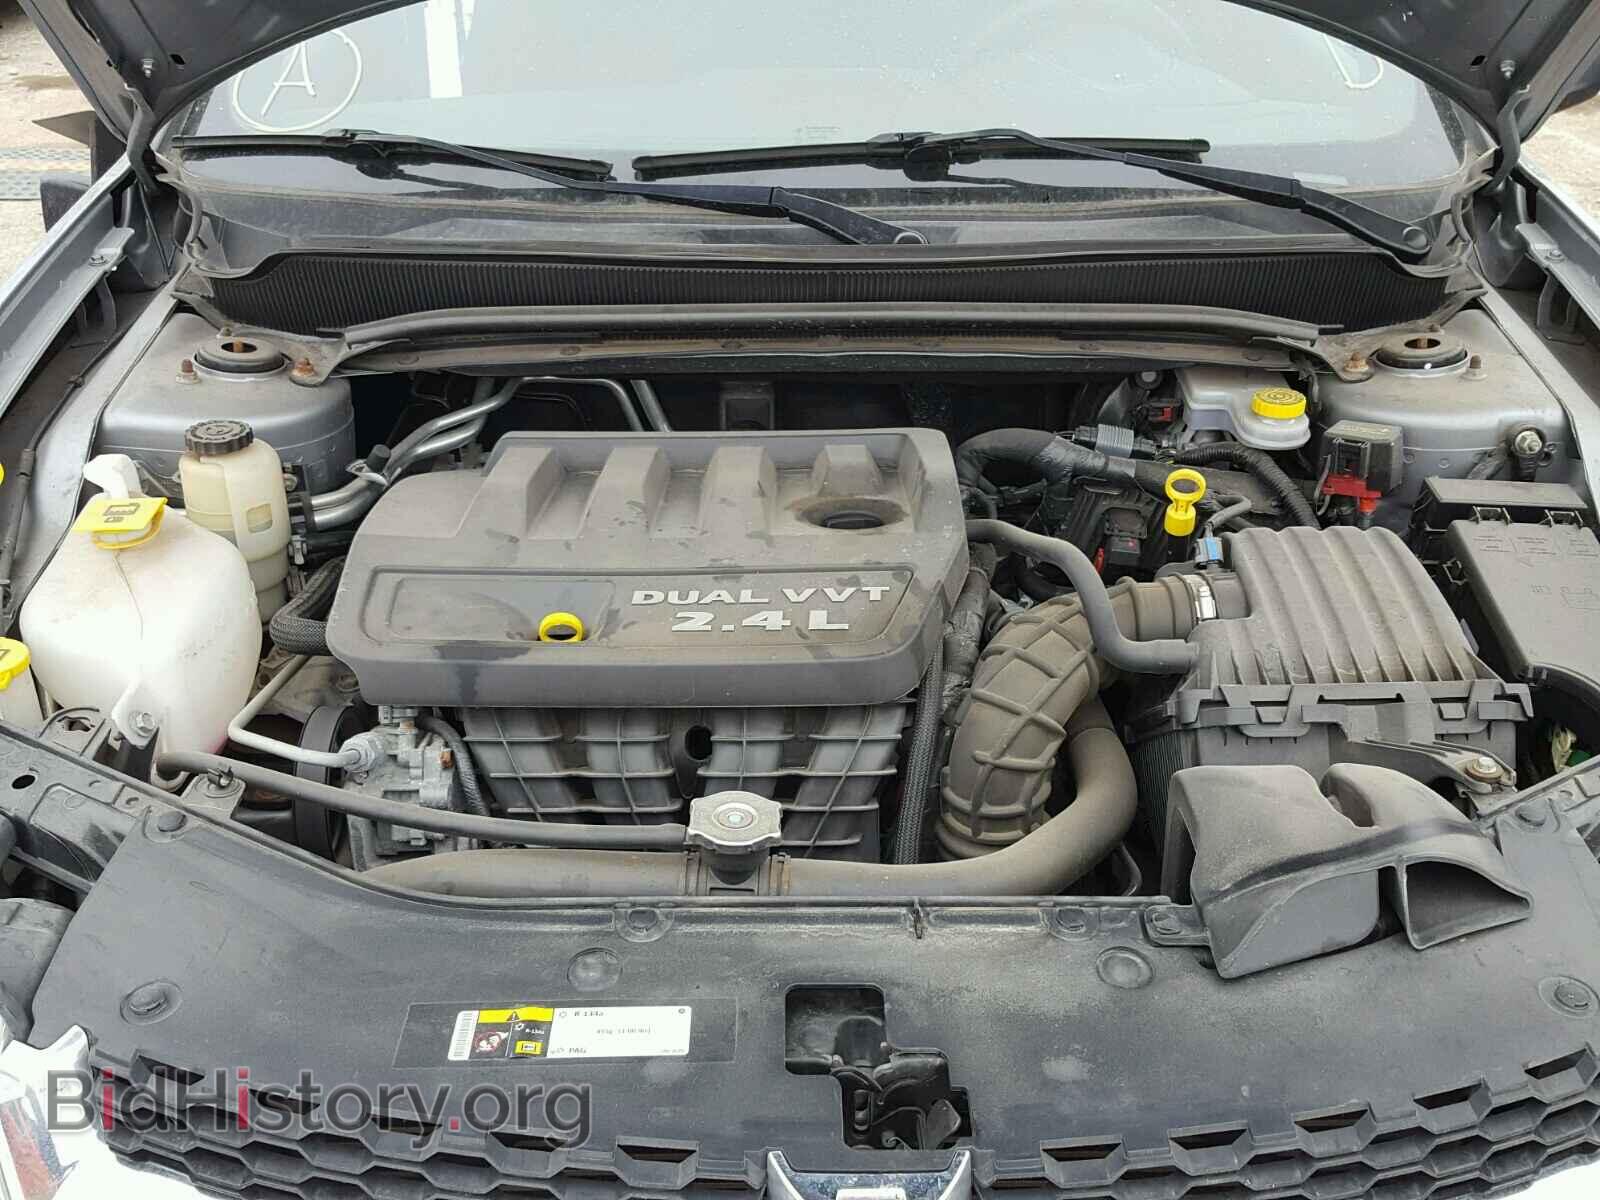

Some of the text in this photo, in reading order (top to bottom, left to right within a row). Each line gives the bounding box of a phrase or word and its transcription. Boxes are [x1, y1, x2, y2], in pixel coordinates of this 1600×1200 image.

[631, 586, 891, 605] DUAL VVT
[671, 609, 850, 632] 2.4 L
